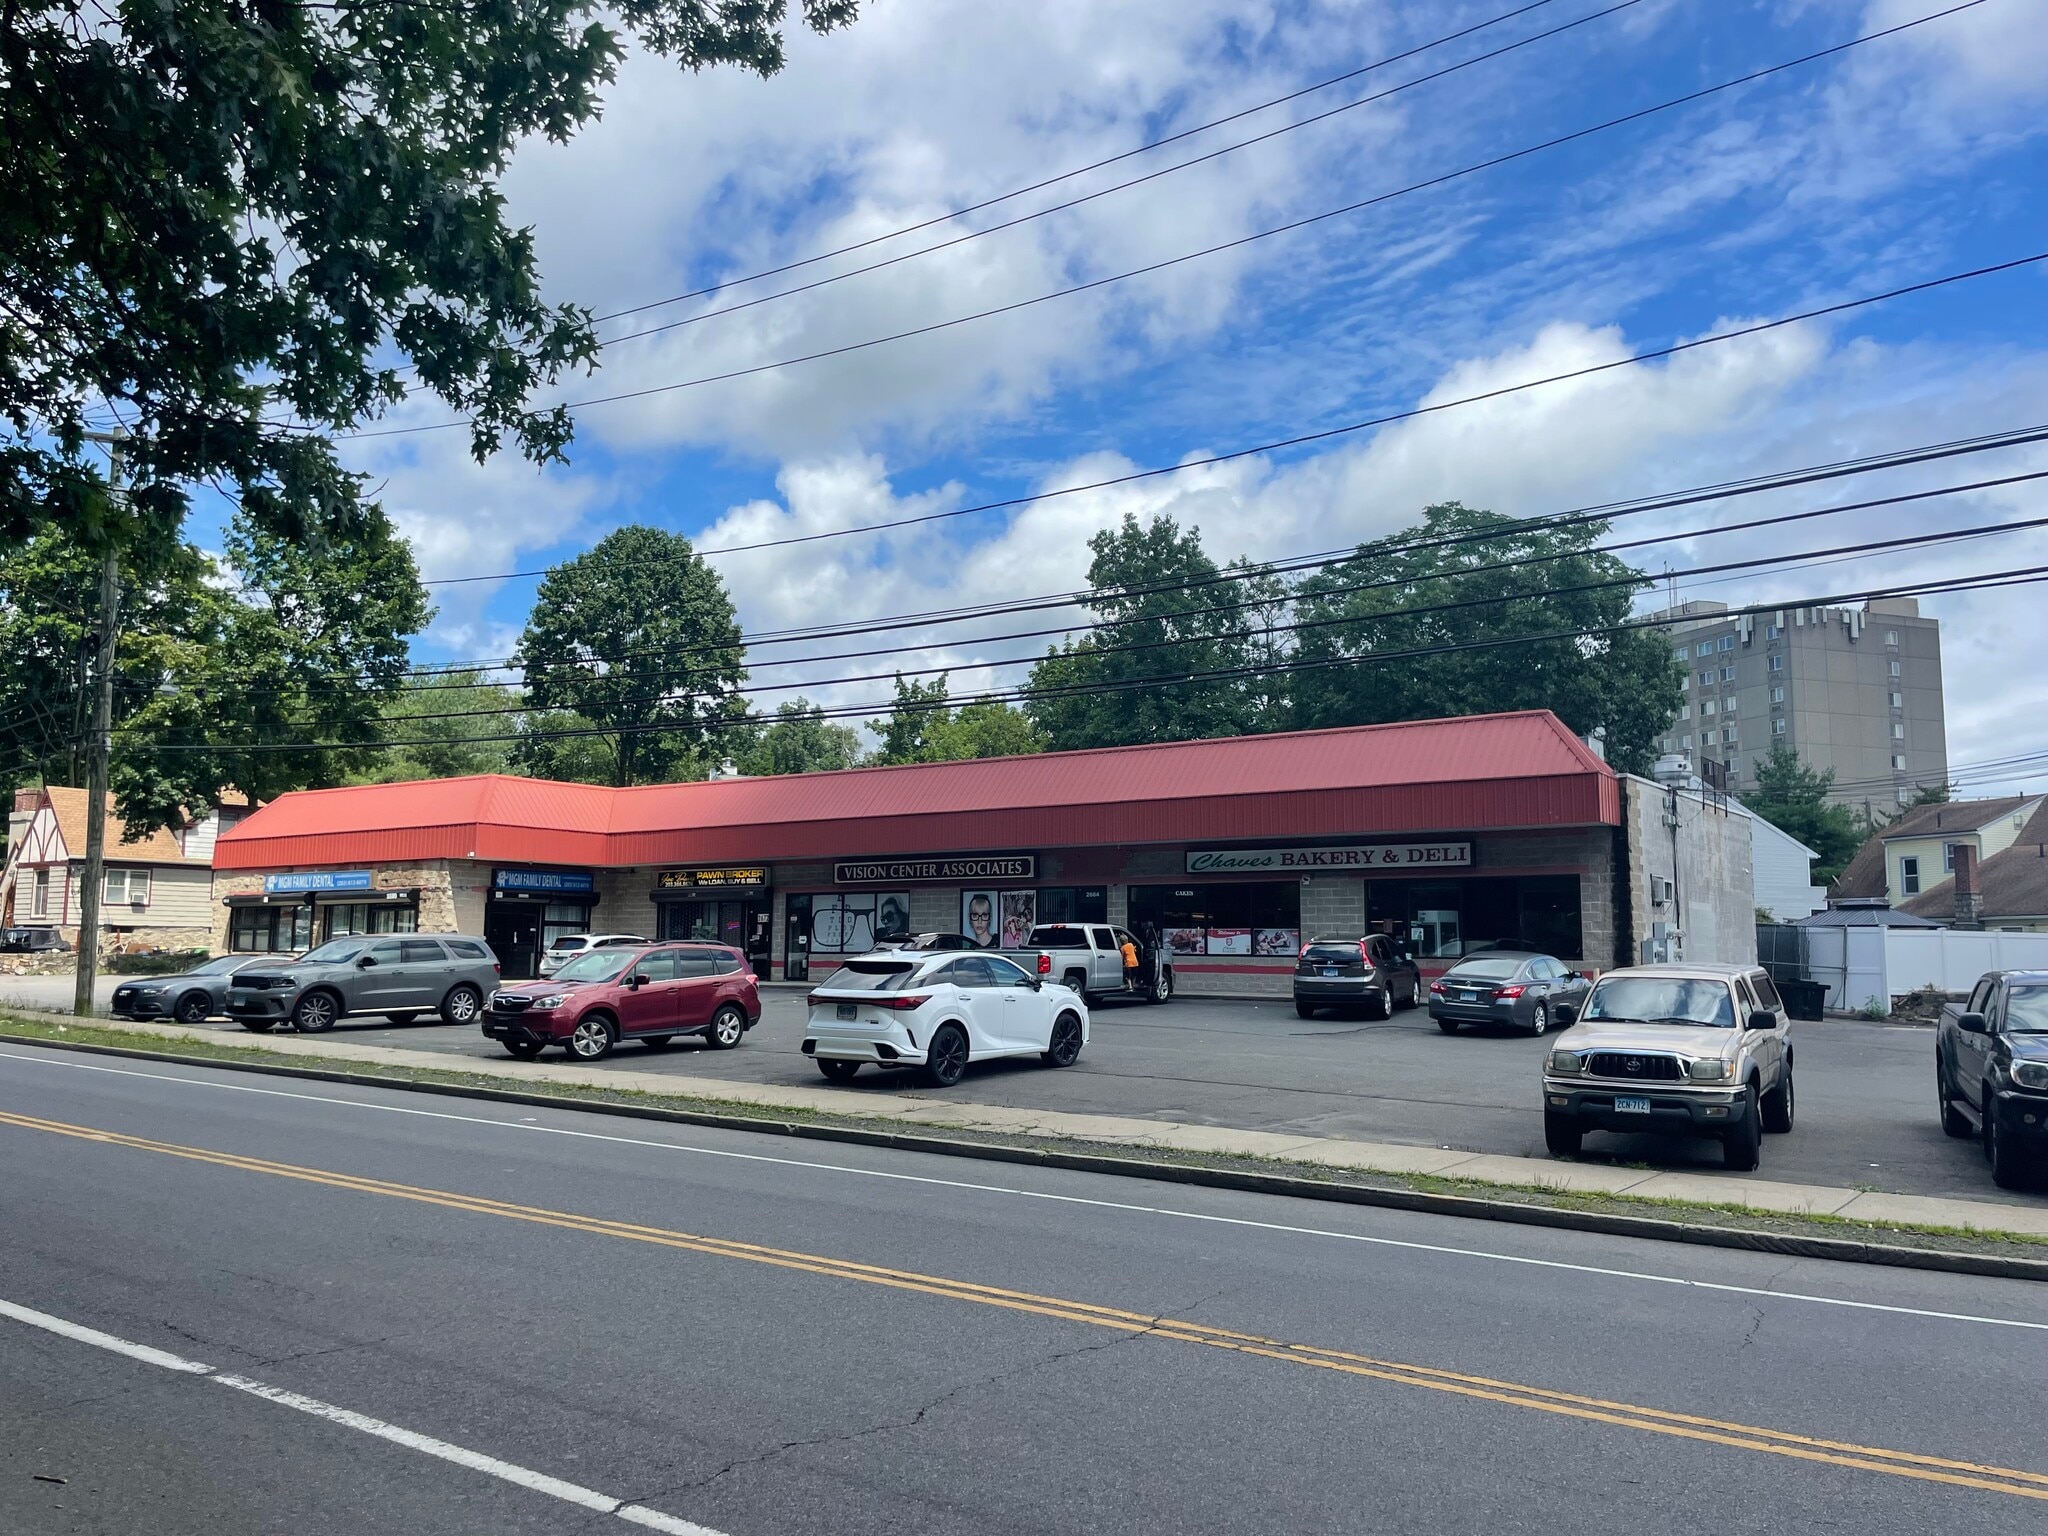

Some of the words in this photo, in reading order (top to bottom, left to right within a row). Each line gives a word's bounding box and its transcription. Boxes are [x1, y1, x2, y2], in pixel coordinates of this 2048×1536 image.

[1190, 853, 1274, 871] Chaves
[1280, 849, 1376, 866] BAKERY
[1382, 849, 1400, 864] &
[1406, 847, 1467, 862] DELI
[696, 871, 725, 879] PAWN
[725, 869, 764, 878] BROKER
[844, 865, 886, 879] VISION
[890, 864, 937, 878] CENTER
[942, 861, 1022, 876] ASSOCIATES
[277, 876, 292, 888] MGM
[292, 875, 312, 888] FAMILY
[312, 874, 335, 887] DENTAL
[508, 873, 522, 886] MGM
[523, 874, 541, 887] FAMILY
[541, 874, 562, 888] DENTAL
